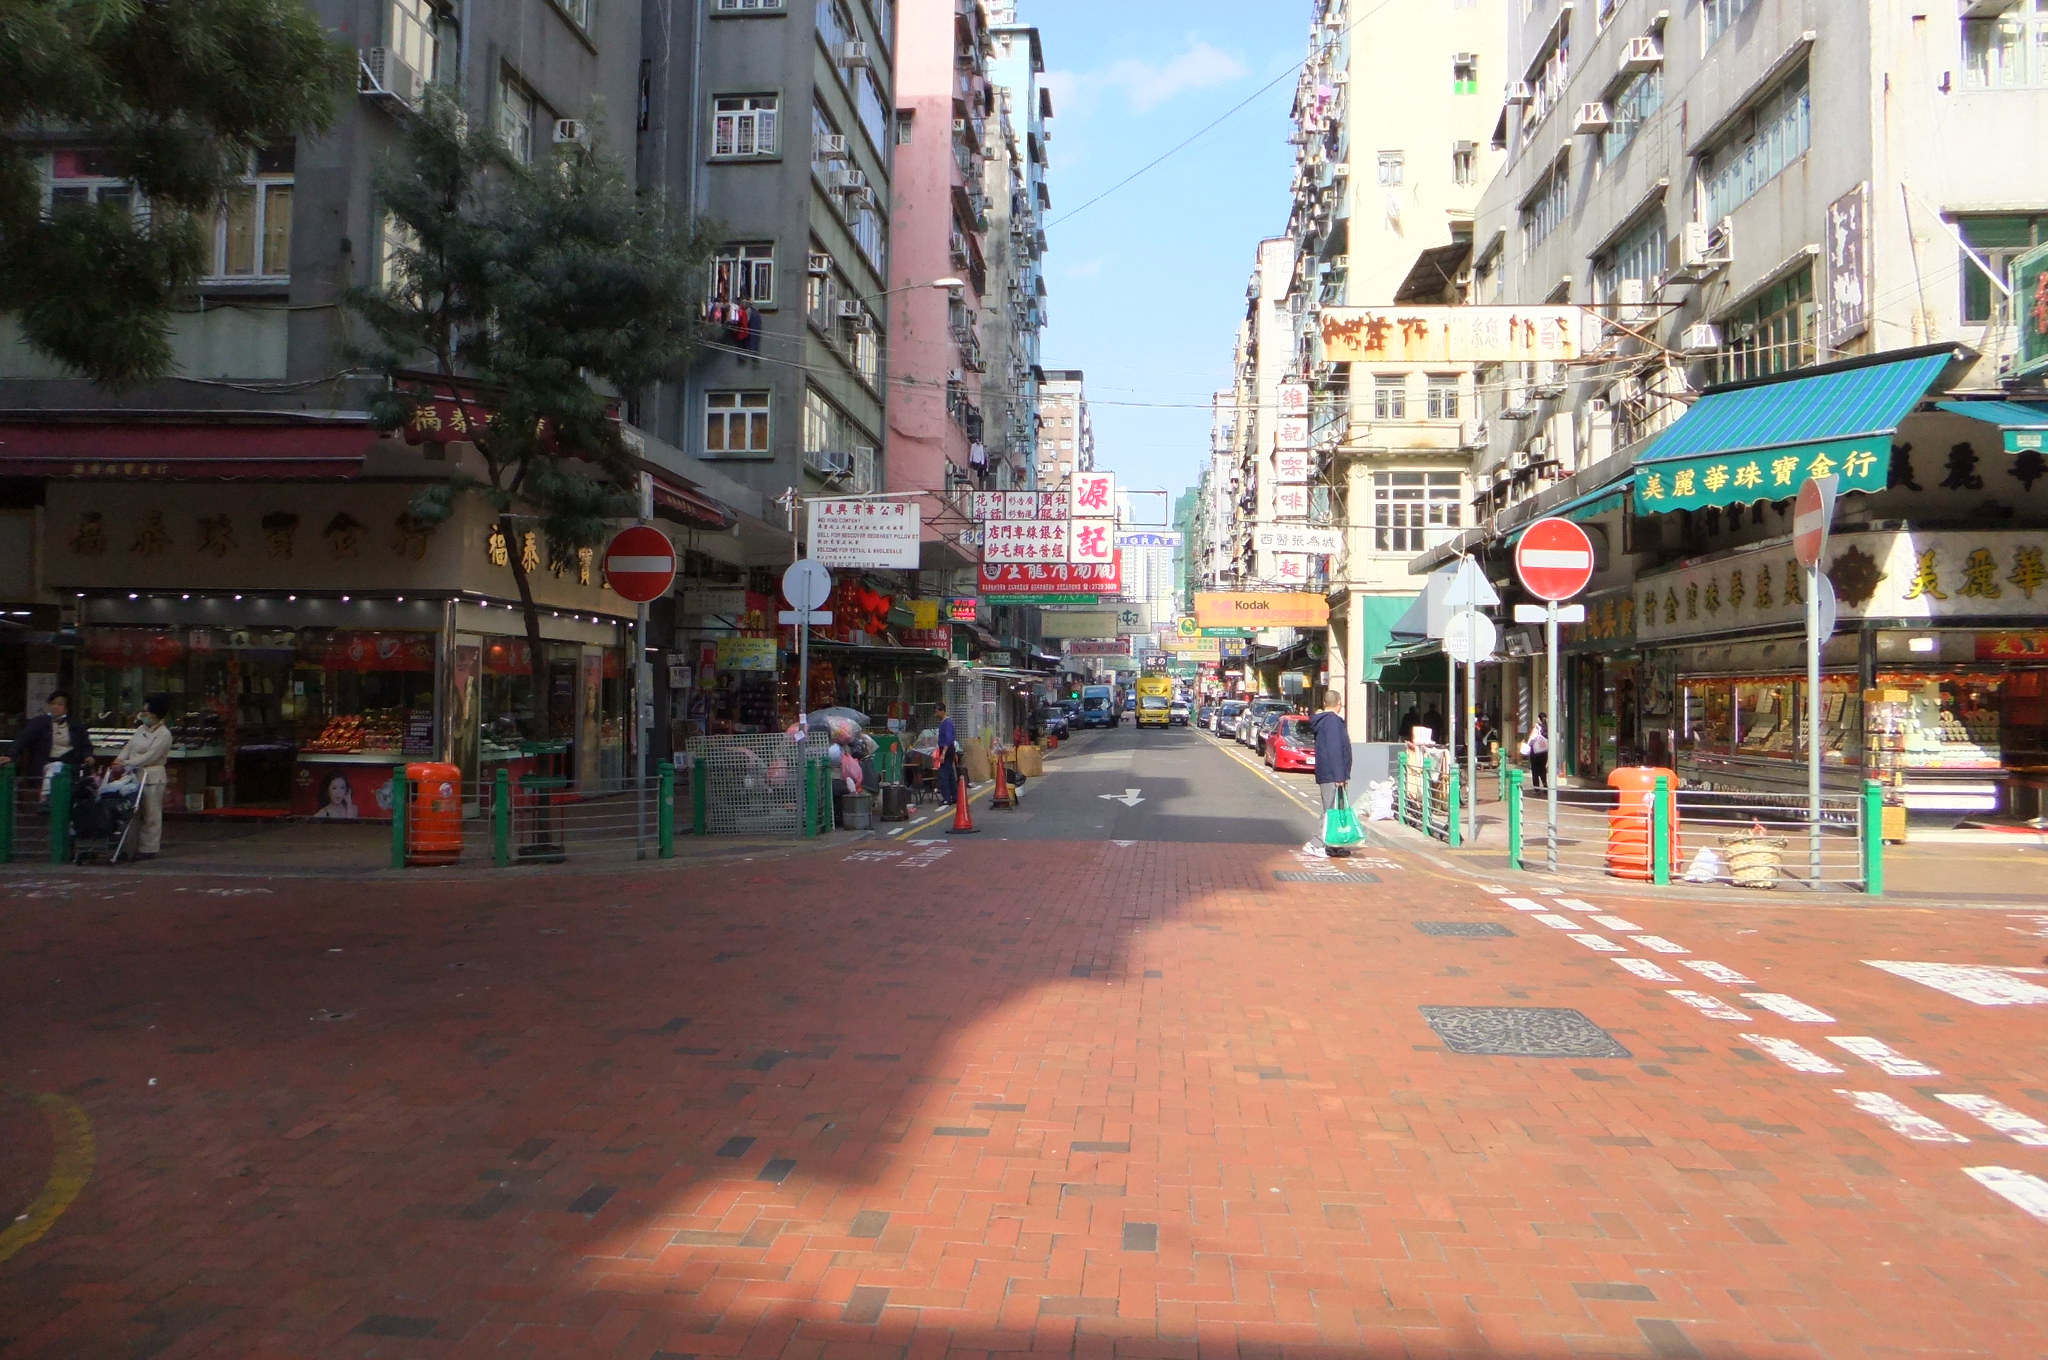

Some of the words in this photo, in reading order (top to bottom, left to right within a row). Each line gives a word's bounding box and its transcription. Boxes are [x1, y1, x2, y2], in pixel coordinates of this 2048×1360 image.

[1642, 450, 1878, 500] 美麗華珠寶金行
[1235, 600, 1270, 610] Kodak
